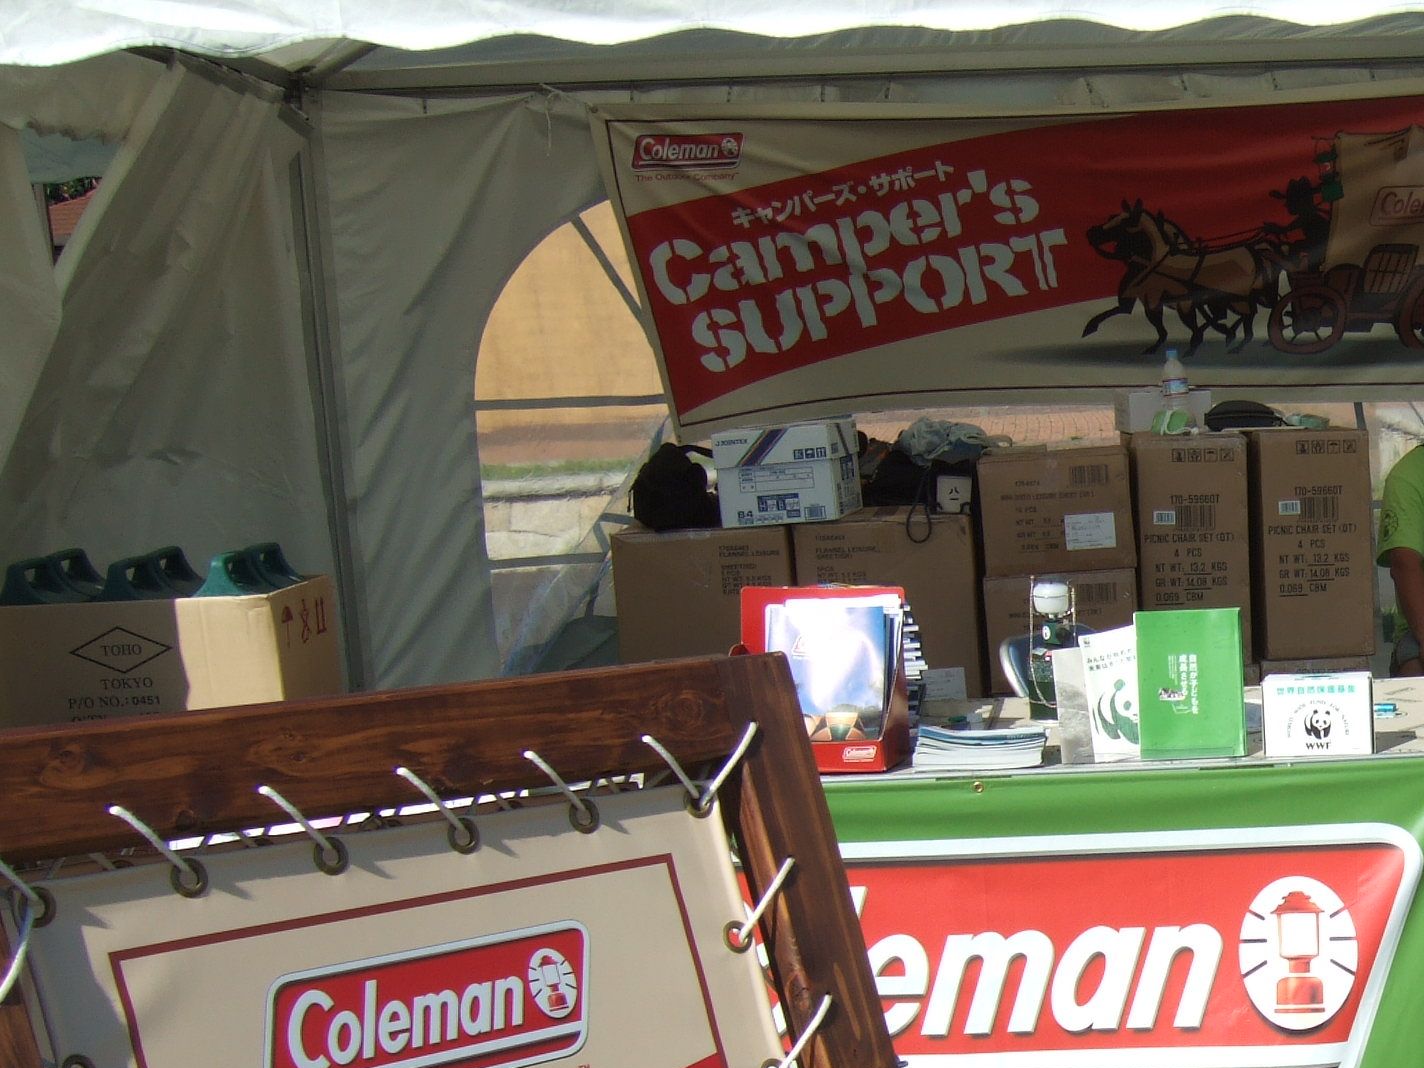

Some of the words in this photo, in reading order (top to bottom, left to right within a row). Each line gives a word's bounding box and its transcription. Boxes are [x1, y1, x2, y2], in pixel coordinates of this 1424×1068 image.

[640, 138, 719, 160] Coleman
[731, 161, 955, 229] キャンパーズ・サポート
[649, 170, 1040, 305] Camper's
[692, 228, 1068, 372] SUPPORT
[1268, 525, 1293, 535] PICNIC
[1296, 525, 1319, 535] CHAIR
[1323, 524, 1336, 534] SET
[1144, 534, 1169, 543] PICNIC
[1172, 533, 1195, 543] CHAIR
[1199, 533, 1213, 542] SET
[1310, 539, 1326, 549] PCS
[1186, 548, 1202, 557] PCS
[1334, 553, 1350, 562] KGS
[1335, 567, 1350, 577] KGS
[1310, 583, 1327, 592] CBM
[101, 644, 142, 656] TOHO
[100, 677, 153, 690] TOKYO
[850, 886, 1223, 1037] eman
